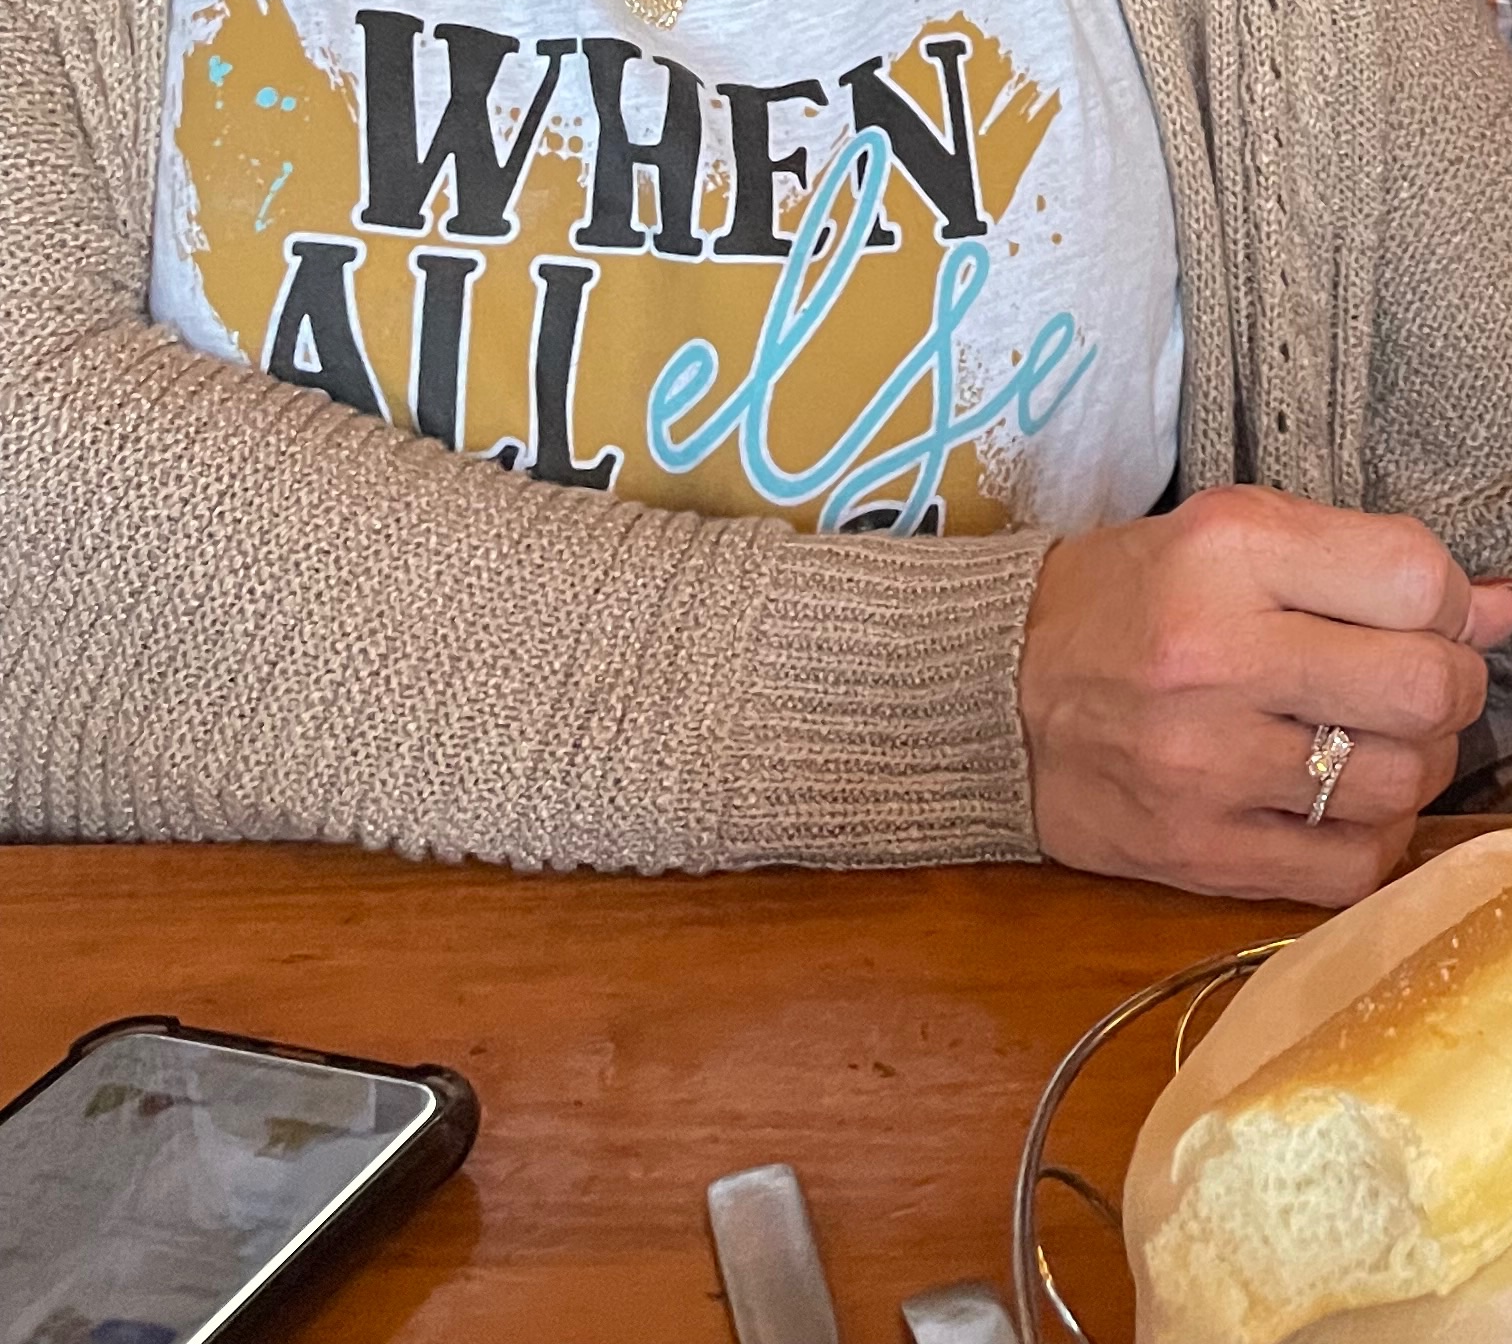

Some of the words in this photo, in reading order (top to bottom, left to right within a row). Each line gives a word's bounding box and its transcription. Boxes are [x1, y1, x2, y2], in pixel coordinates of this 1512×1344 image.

[354, 9, 990, 257] WHEN
[267, 241, 616, 490] ALL
[648, 126, 1098, 536] else
